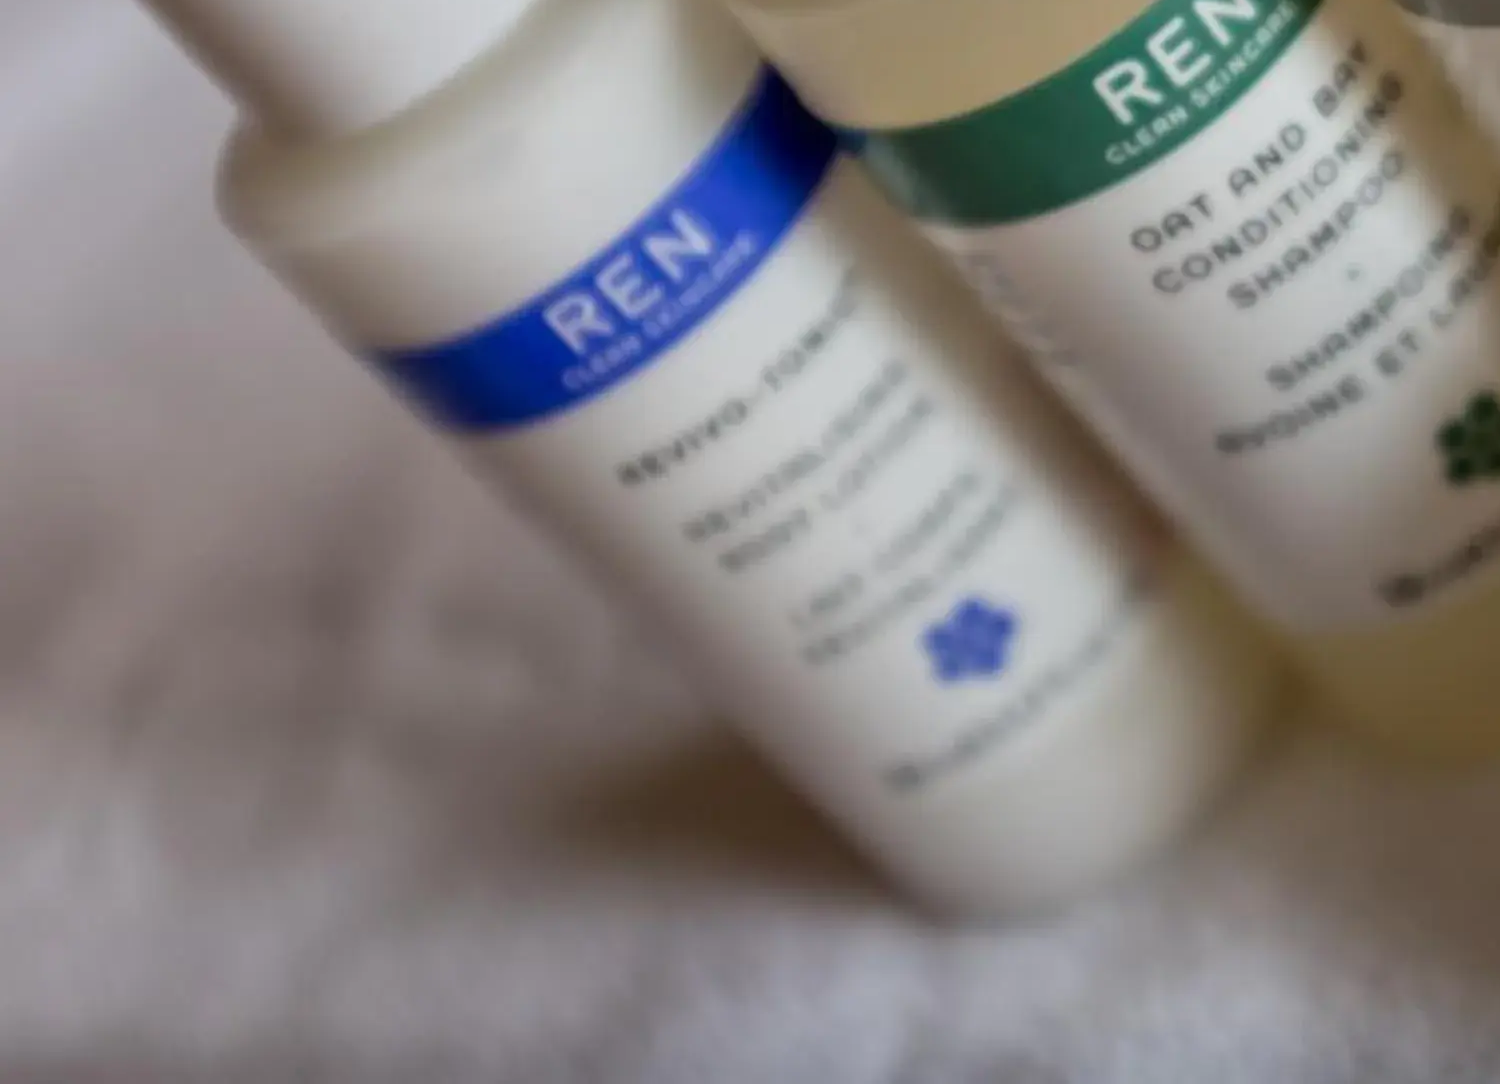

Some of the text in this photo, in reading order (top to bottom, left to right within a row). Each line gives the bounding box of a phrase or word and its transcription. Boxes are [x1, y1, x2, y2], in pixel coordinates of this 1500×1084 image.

[1104, 105, 1189, 165] CLEAN
[1129, 40, 1367, 253] OAT AND BAY
[1152, 68, 1404, 294] CONDITIONING
[542, 207, 713, 355] REN
[1226, 149, 1404, 309] SHAMPOO
